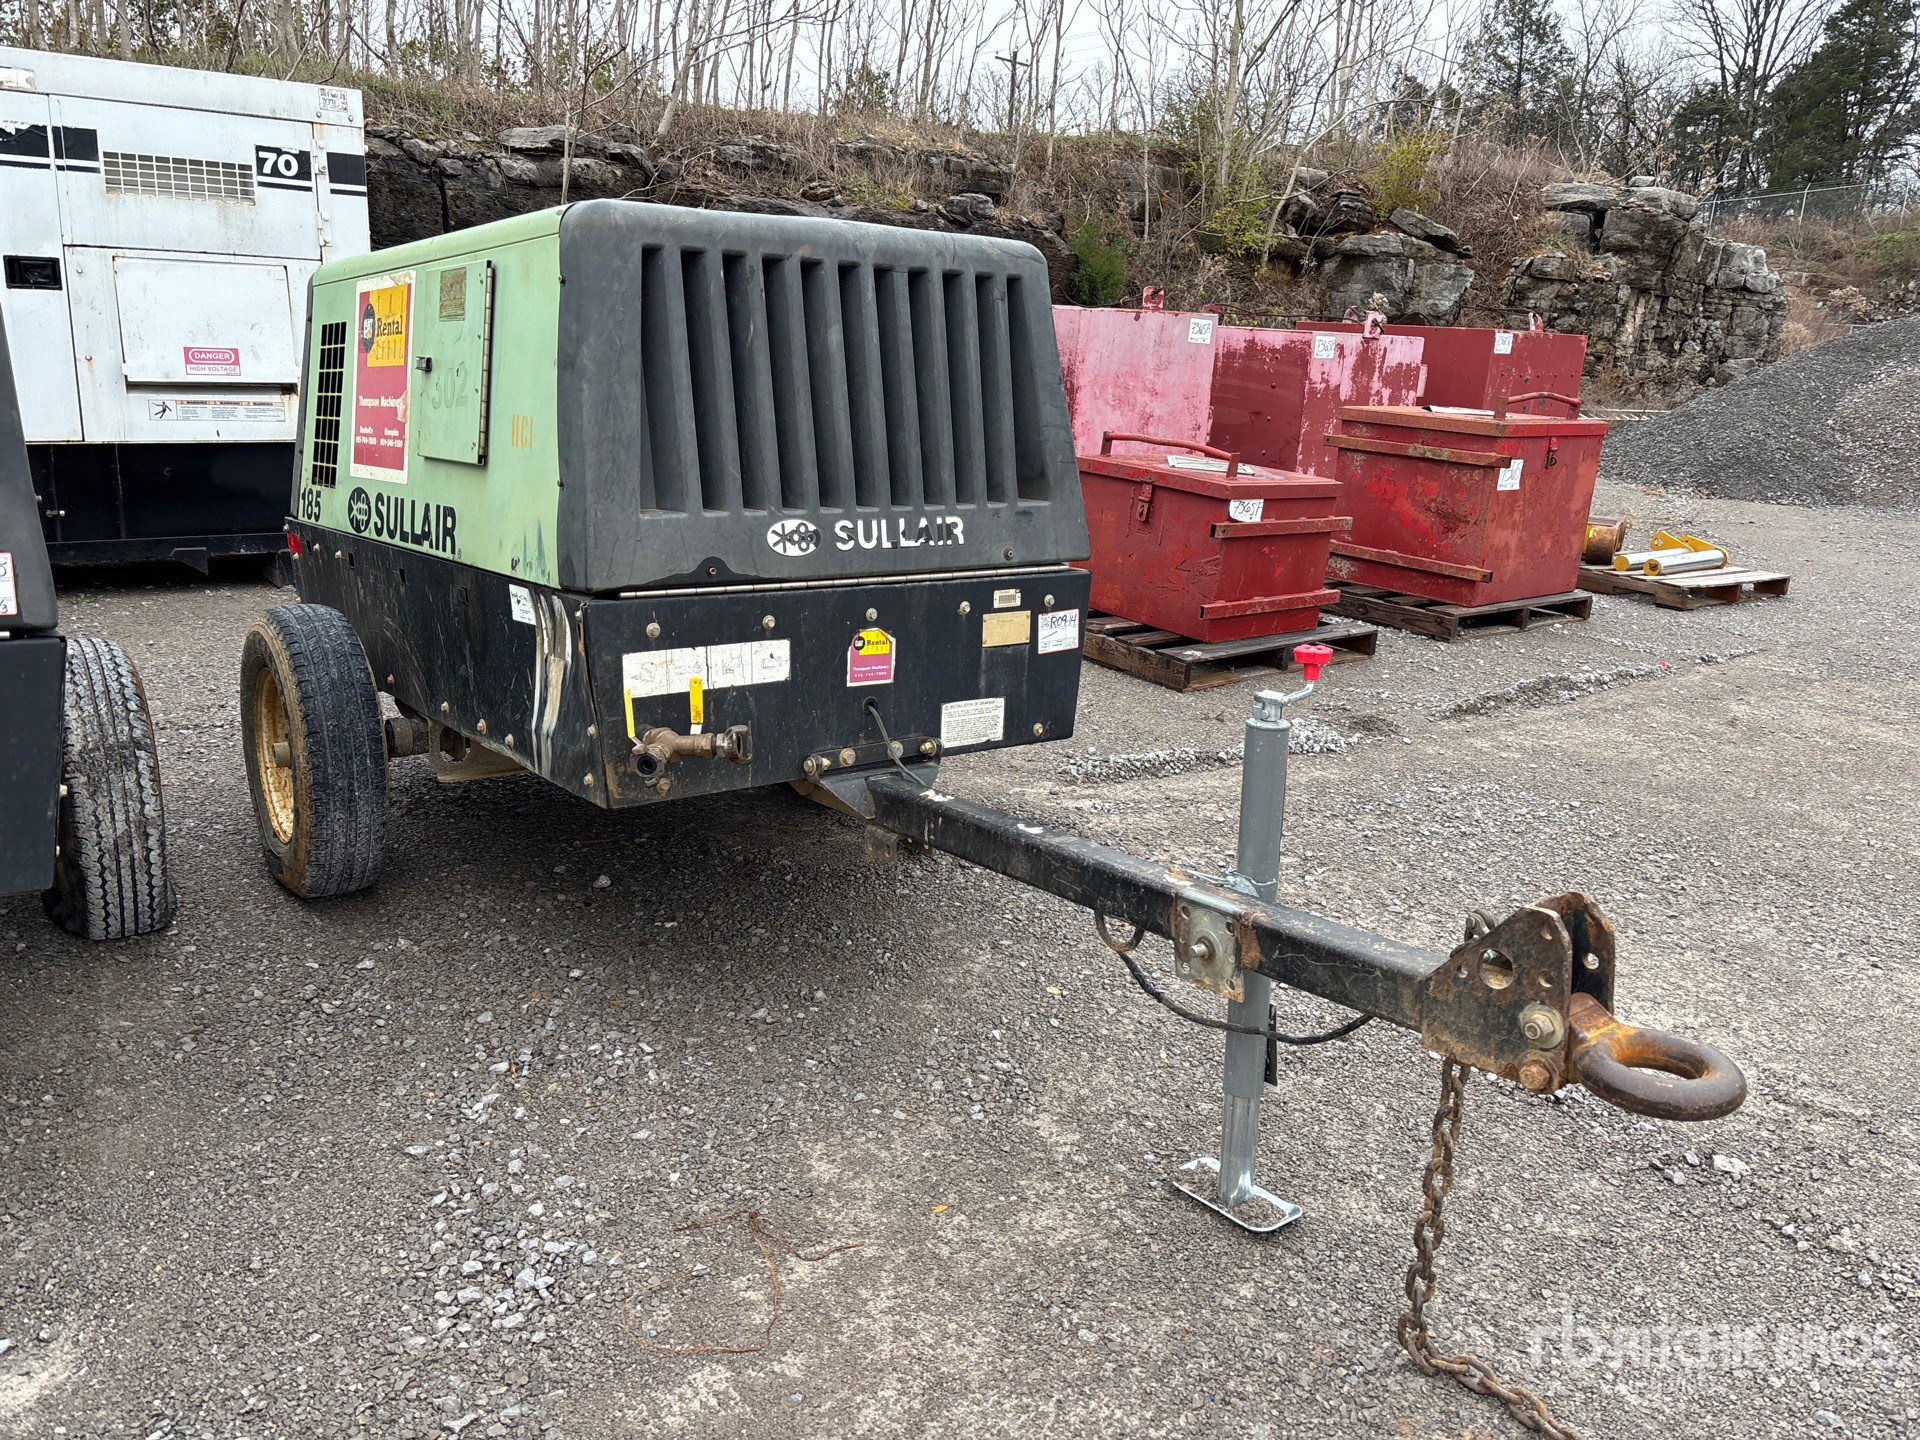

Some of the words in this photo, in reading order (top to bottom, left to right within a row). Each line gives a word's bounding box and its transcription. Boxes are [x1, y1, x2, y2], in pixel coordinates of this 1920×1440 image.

[258, 151, 299, 177] 70
[377, 314, 404, 338] Rental
[194, 352, 231, 361] DANGER
[359, 395, 380, 408] Thompson
[301, 487, 322, 523] 185
[374, 491, 458, 556] SULLAIR
[834, 516, 965, 551] SULLAIR
[866, 638, 888, 646] Rental
